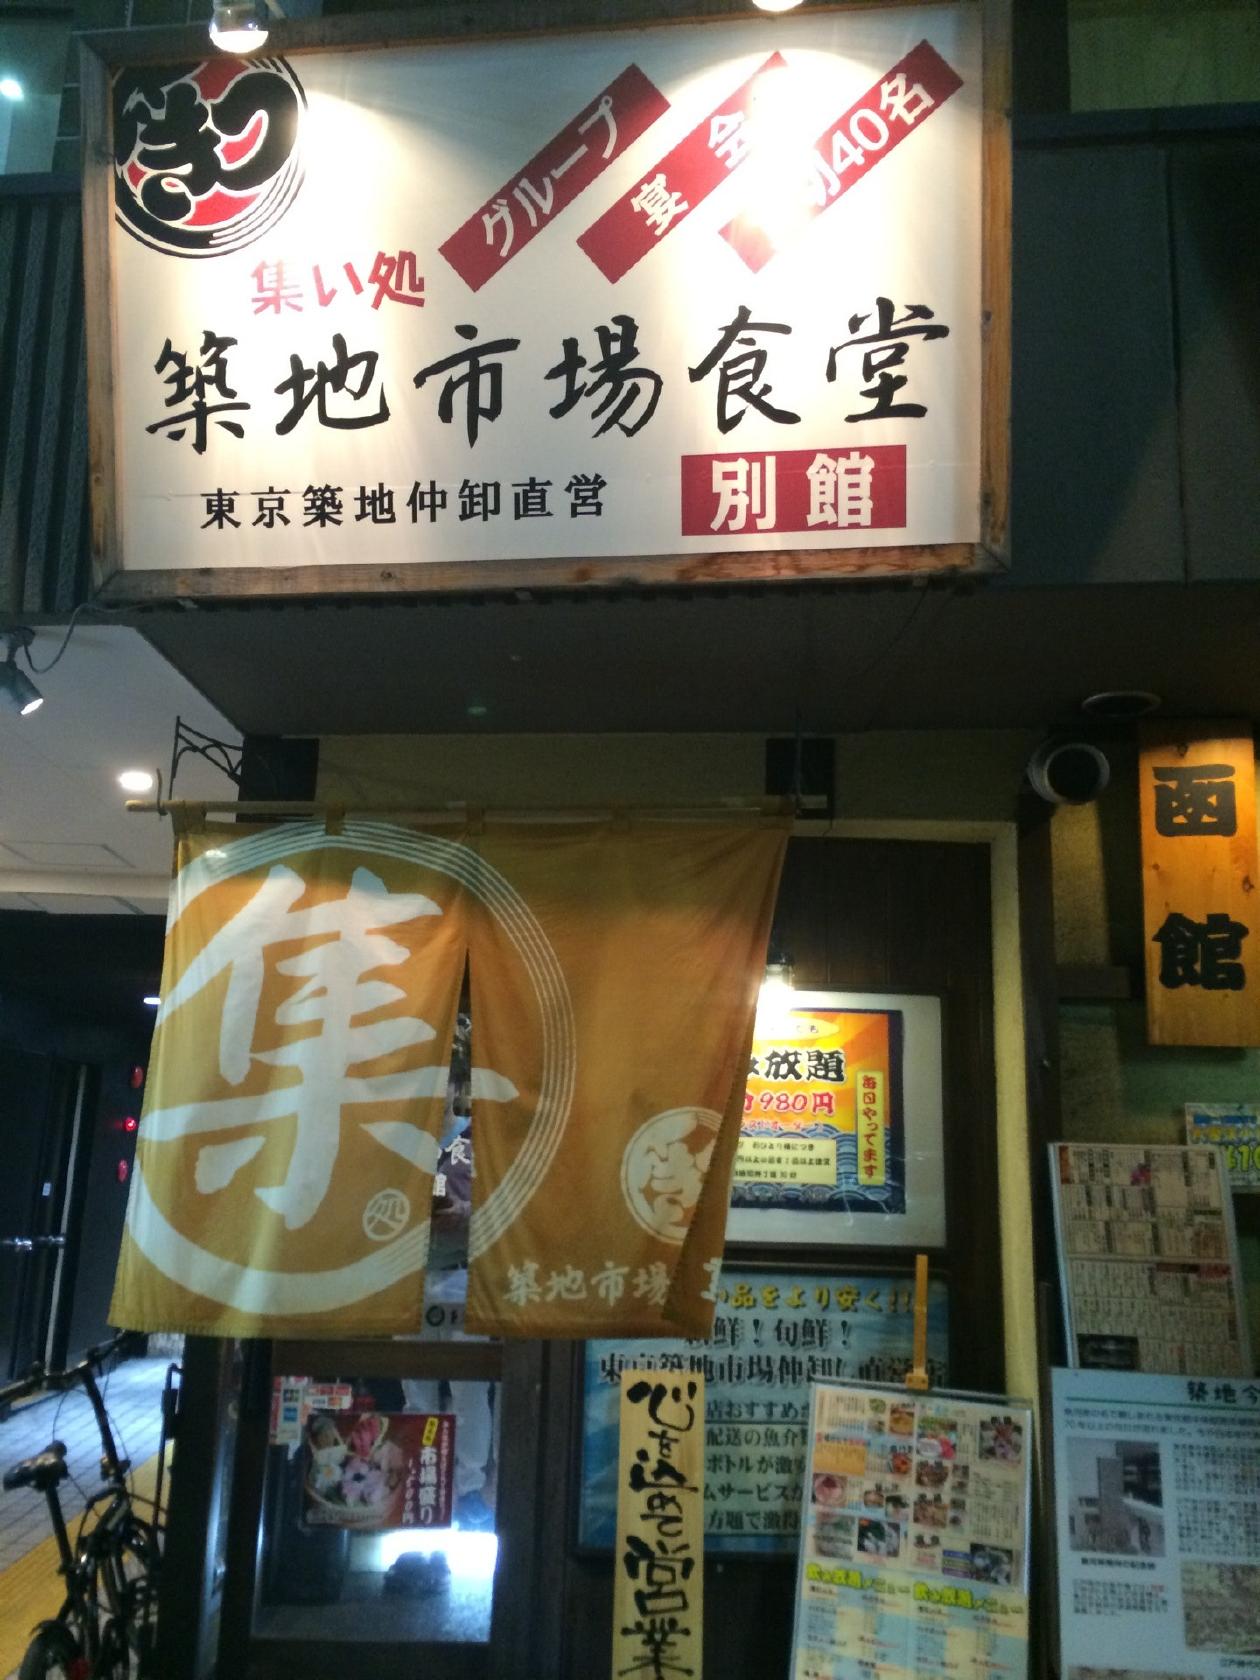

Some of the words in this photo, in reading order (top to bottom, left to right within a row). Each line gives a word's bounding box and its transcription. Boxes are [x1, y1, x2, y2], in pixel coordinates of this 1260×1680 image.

[481, 95, 619, 257] グループ
[251, 249, 426, 316] 集い処
[145, 297, 949, 455] 築地市場食堂
[200, 472, 607, 530] 東京築地仲卸直営
[709, 451, 876, 533] 別館
[138, 864, 519, 1231] 集
[503, 1257, 722, 1306] 築地市場
